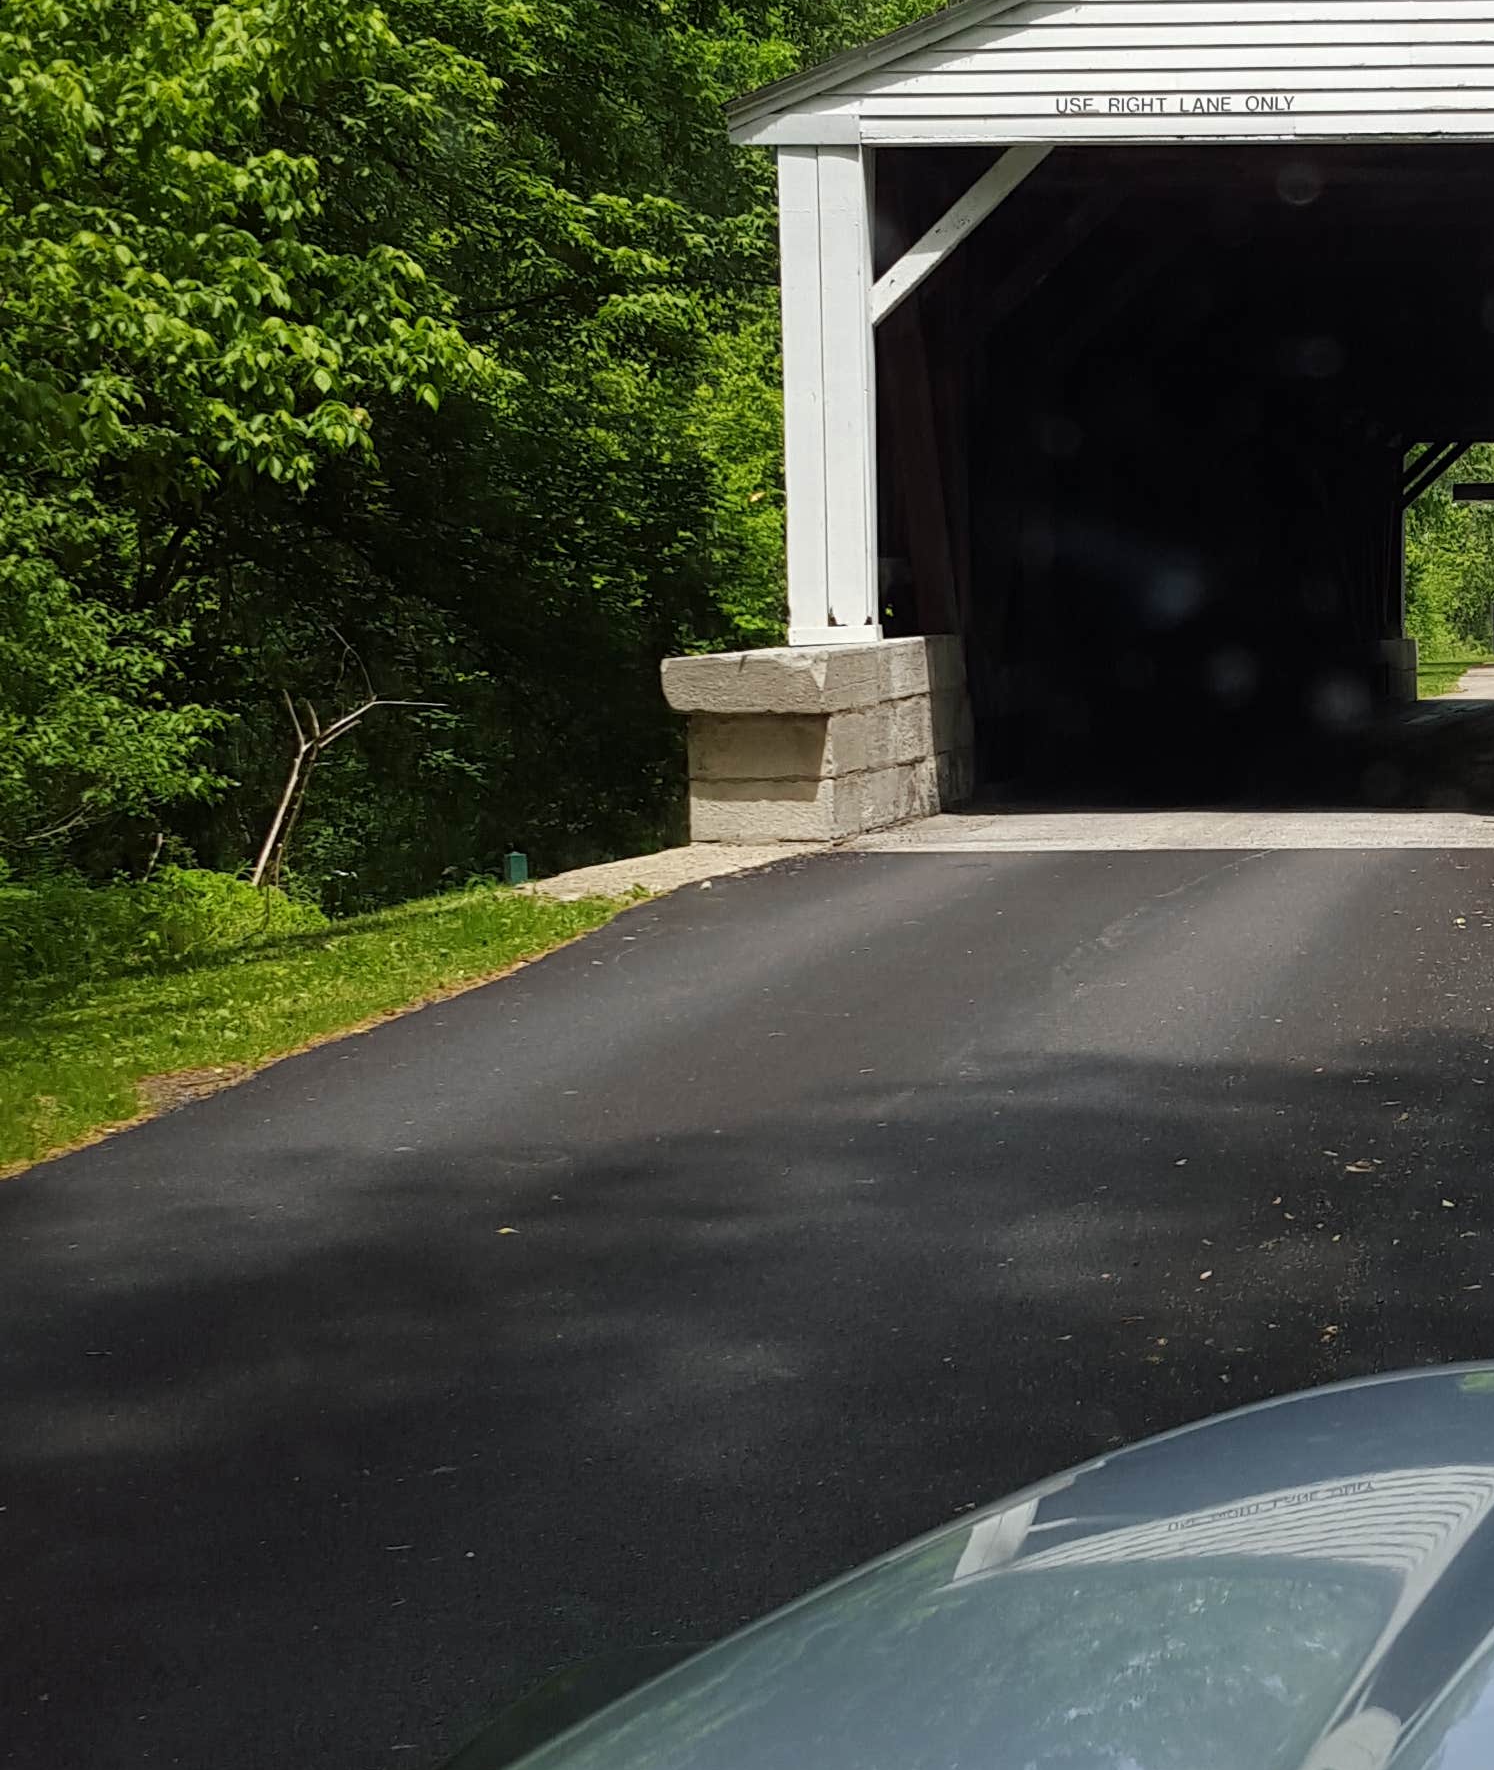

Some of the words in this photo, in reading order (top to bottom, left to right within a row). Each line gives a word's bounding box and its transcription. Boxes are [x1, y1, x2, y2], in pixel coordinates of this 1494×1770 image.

[1056, 98, 1094, 114] USE
[1108, 96, 1167, 113] RIGHT
[1179, 96, 1231, 113] LANE
[1245, 95, 1295, 111] ONLY
